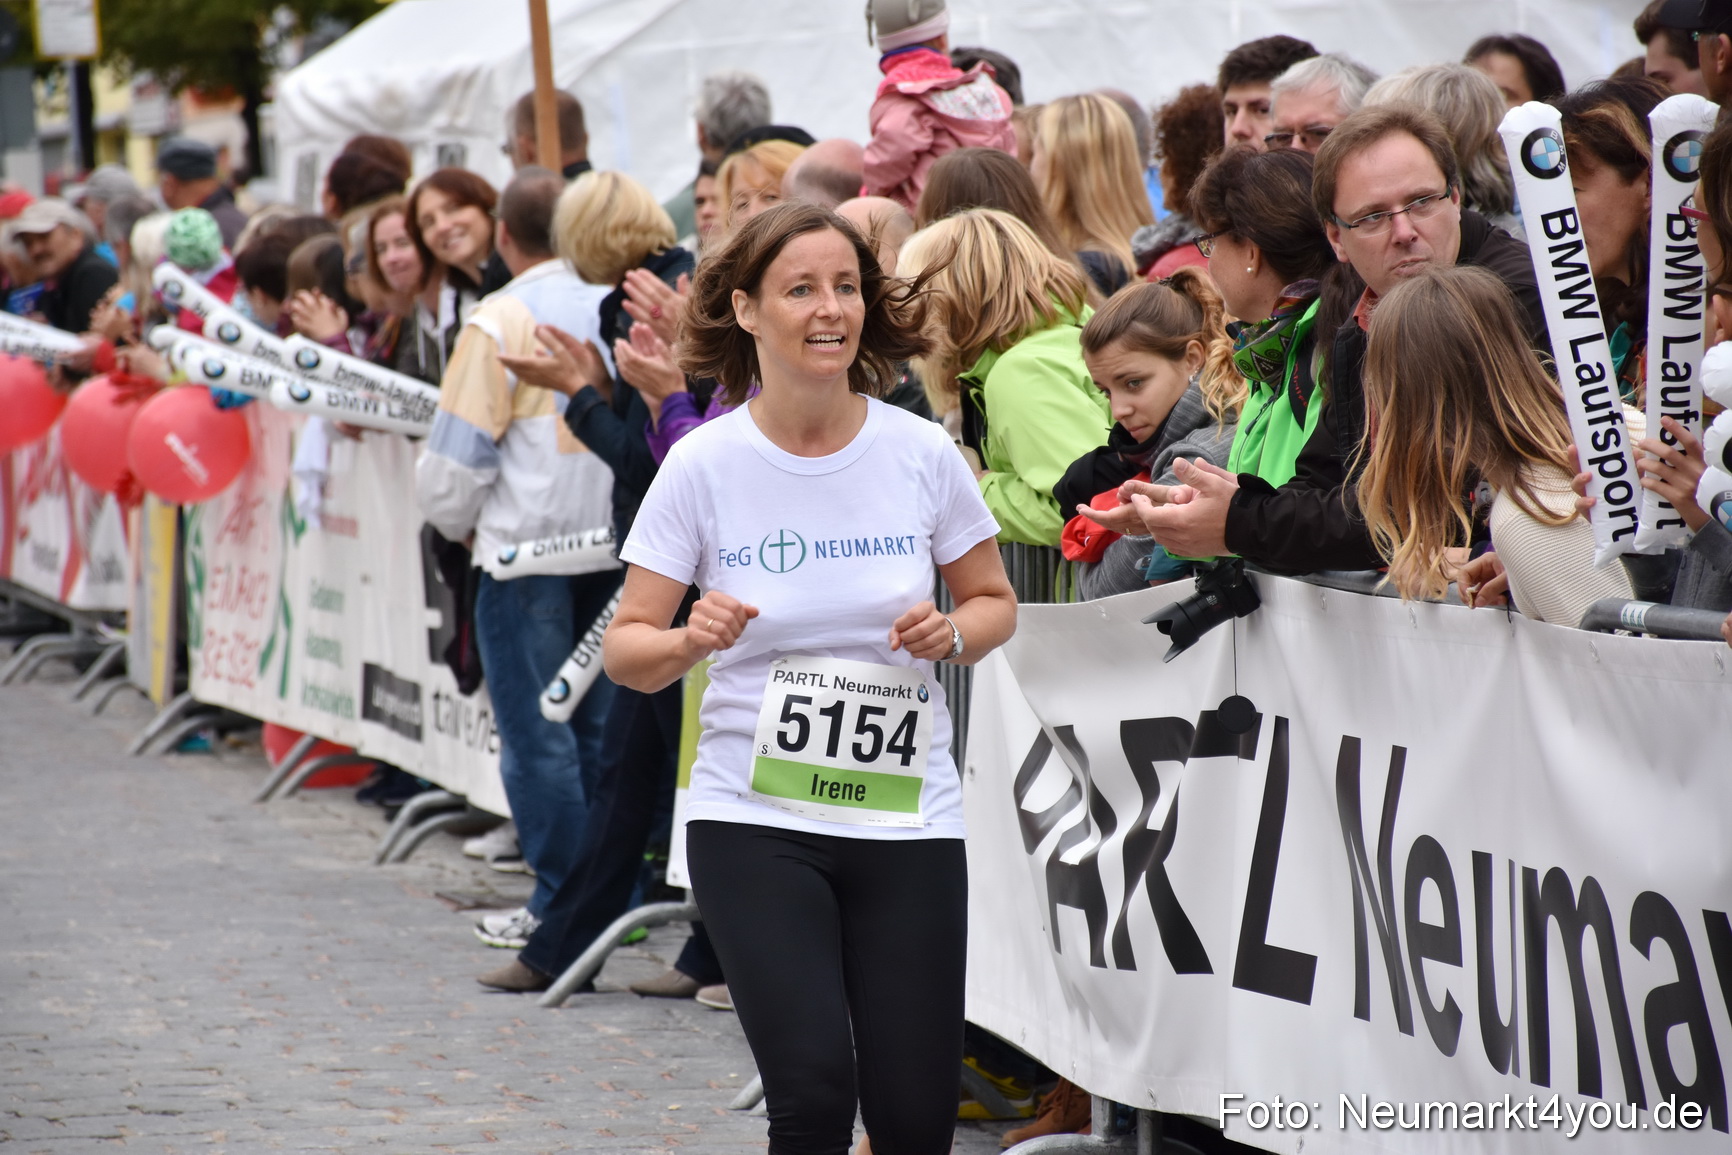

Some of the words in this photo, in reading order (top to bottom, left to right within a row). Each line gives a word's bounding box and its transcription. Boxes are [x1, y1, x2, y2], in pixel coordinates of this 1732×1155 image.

[1541, 206, 1601, 320] BMW
[1663, 213, 1703, 321] BMW
[1569, 331, 1638, 544] Laufsport
[718, 546, 752, 569] FeG
[814, 535, 916, 560] NEUMARKT
[772, 669, 829, 689] PARTL
[833, 675, 913, 700] Neumarkt
[760, 743, 769, 756] S
[776, 693, 919, 768] 5154
[810, 773, 867, 803] Irene
